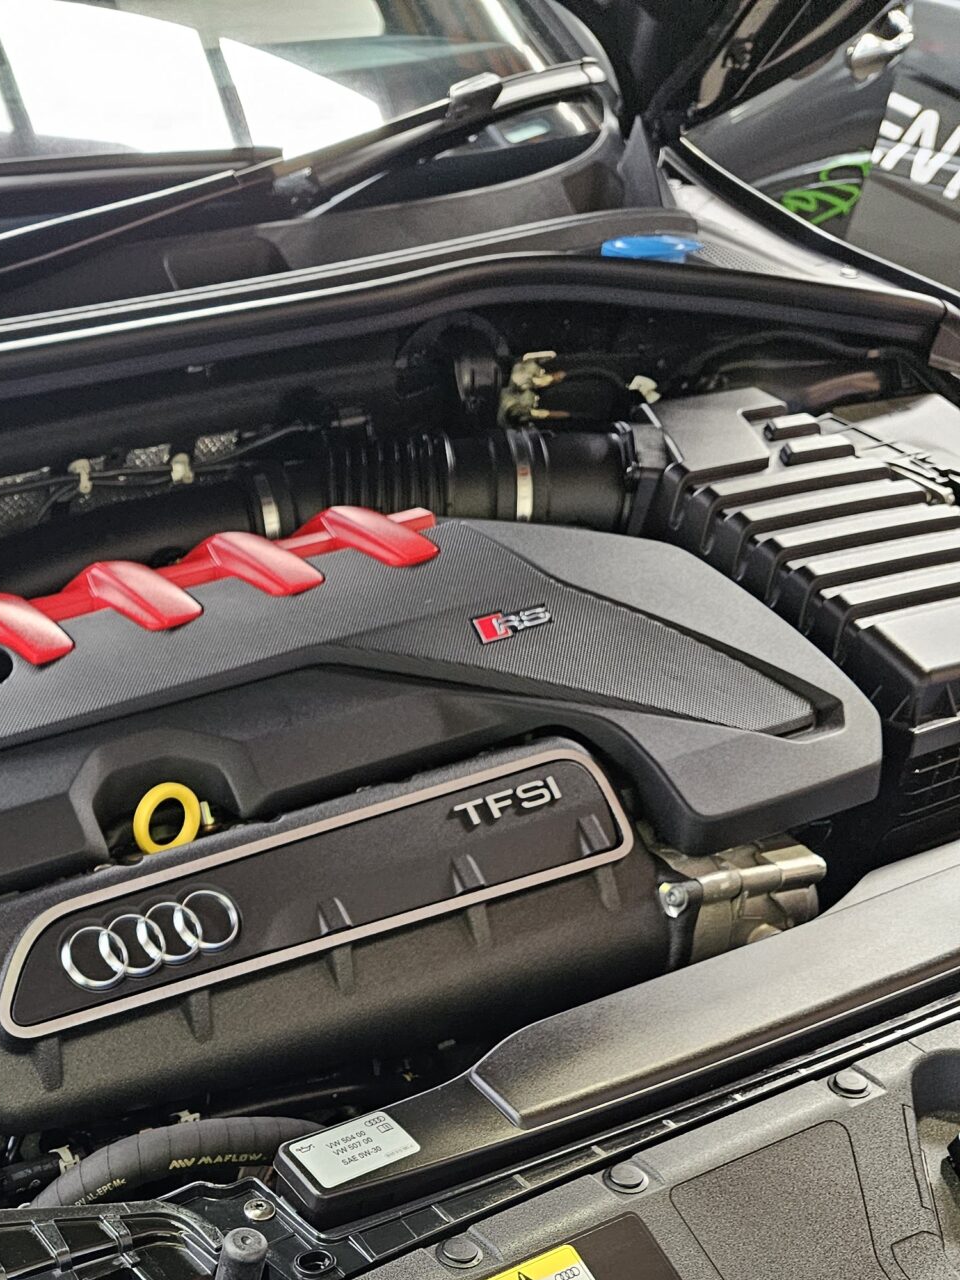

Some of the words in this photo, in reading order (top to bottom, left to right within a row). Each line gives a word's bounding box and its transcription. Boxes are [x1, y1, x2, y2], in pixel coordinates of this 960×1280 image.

[490, 606, 552, 636] RS
[453, 775, 563, 825] TFSI
[325, 1139, 341, 1149] VW
[340, 1135, 356, 1144] 504
[355, 1130, 366, 1138] 00
[332, 1146, 348, 1156] VW
[348, 1141, 362, 1151] 507
[362, 1136, 373, 1145] 00
[341, 1154, 359, 1166] SAE
[359, 1145, 382, 1159] 0W-30
